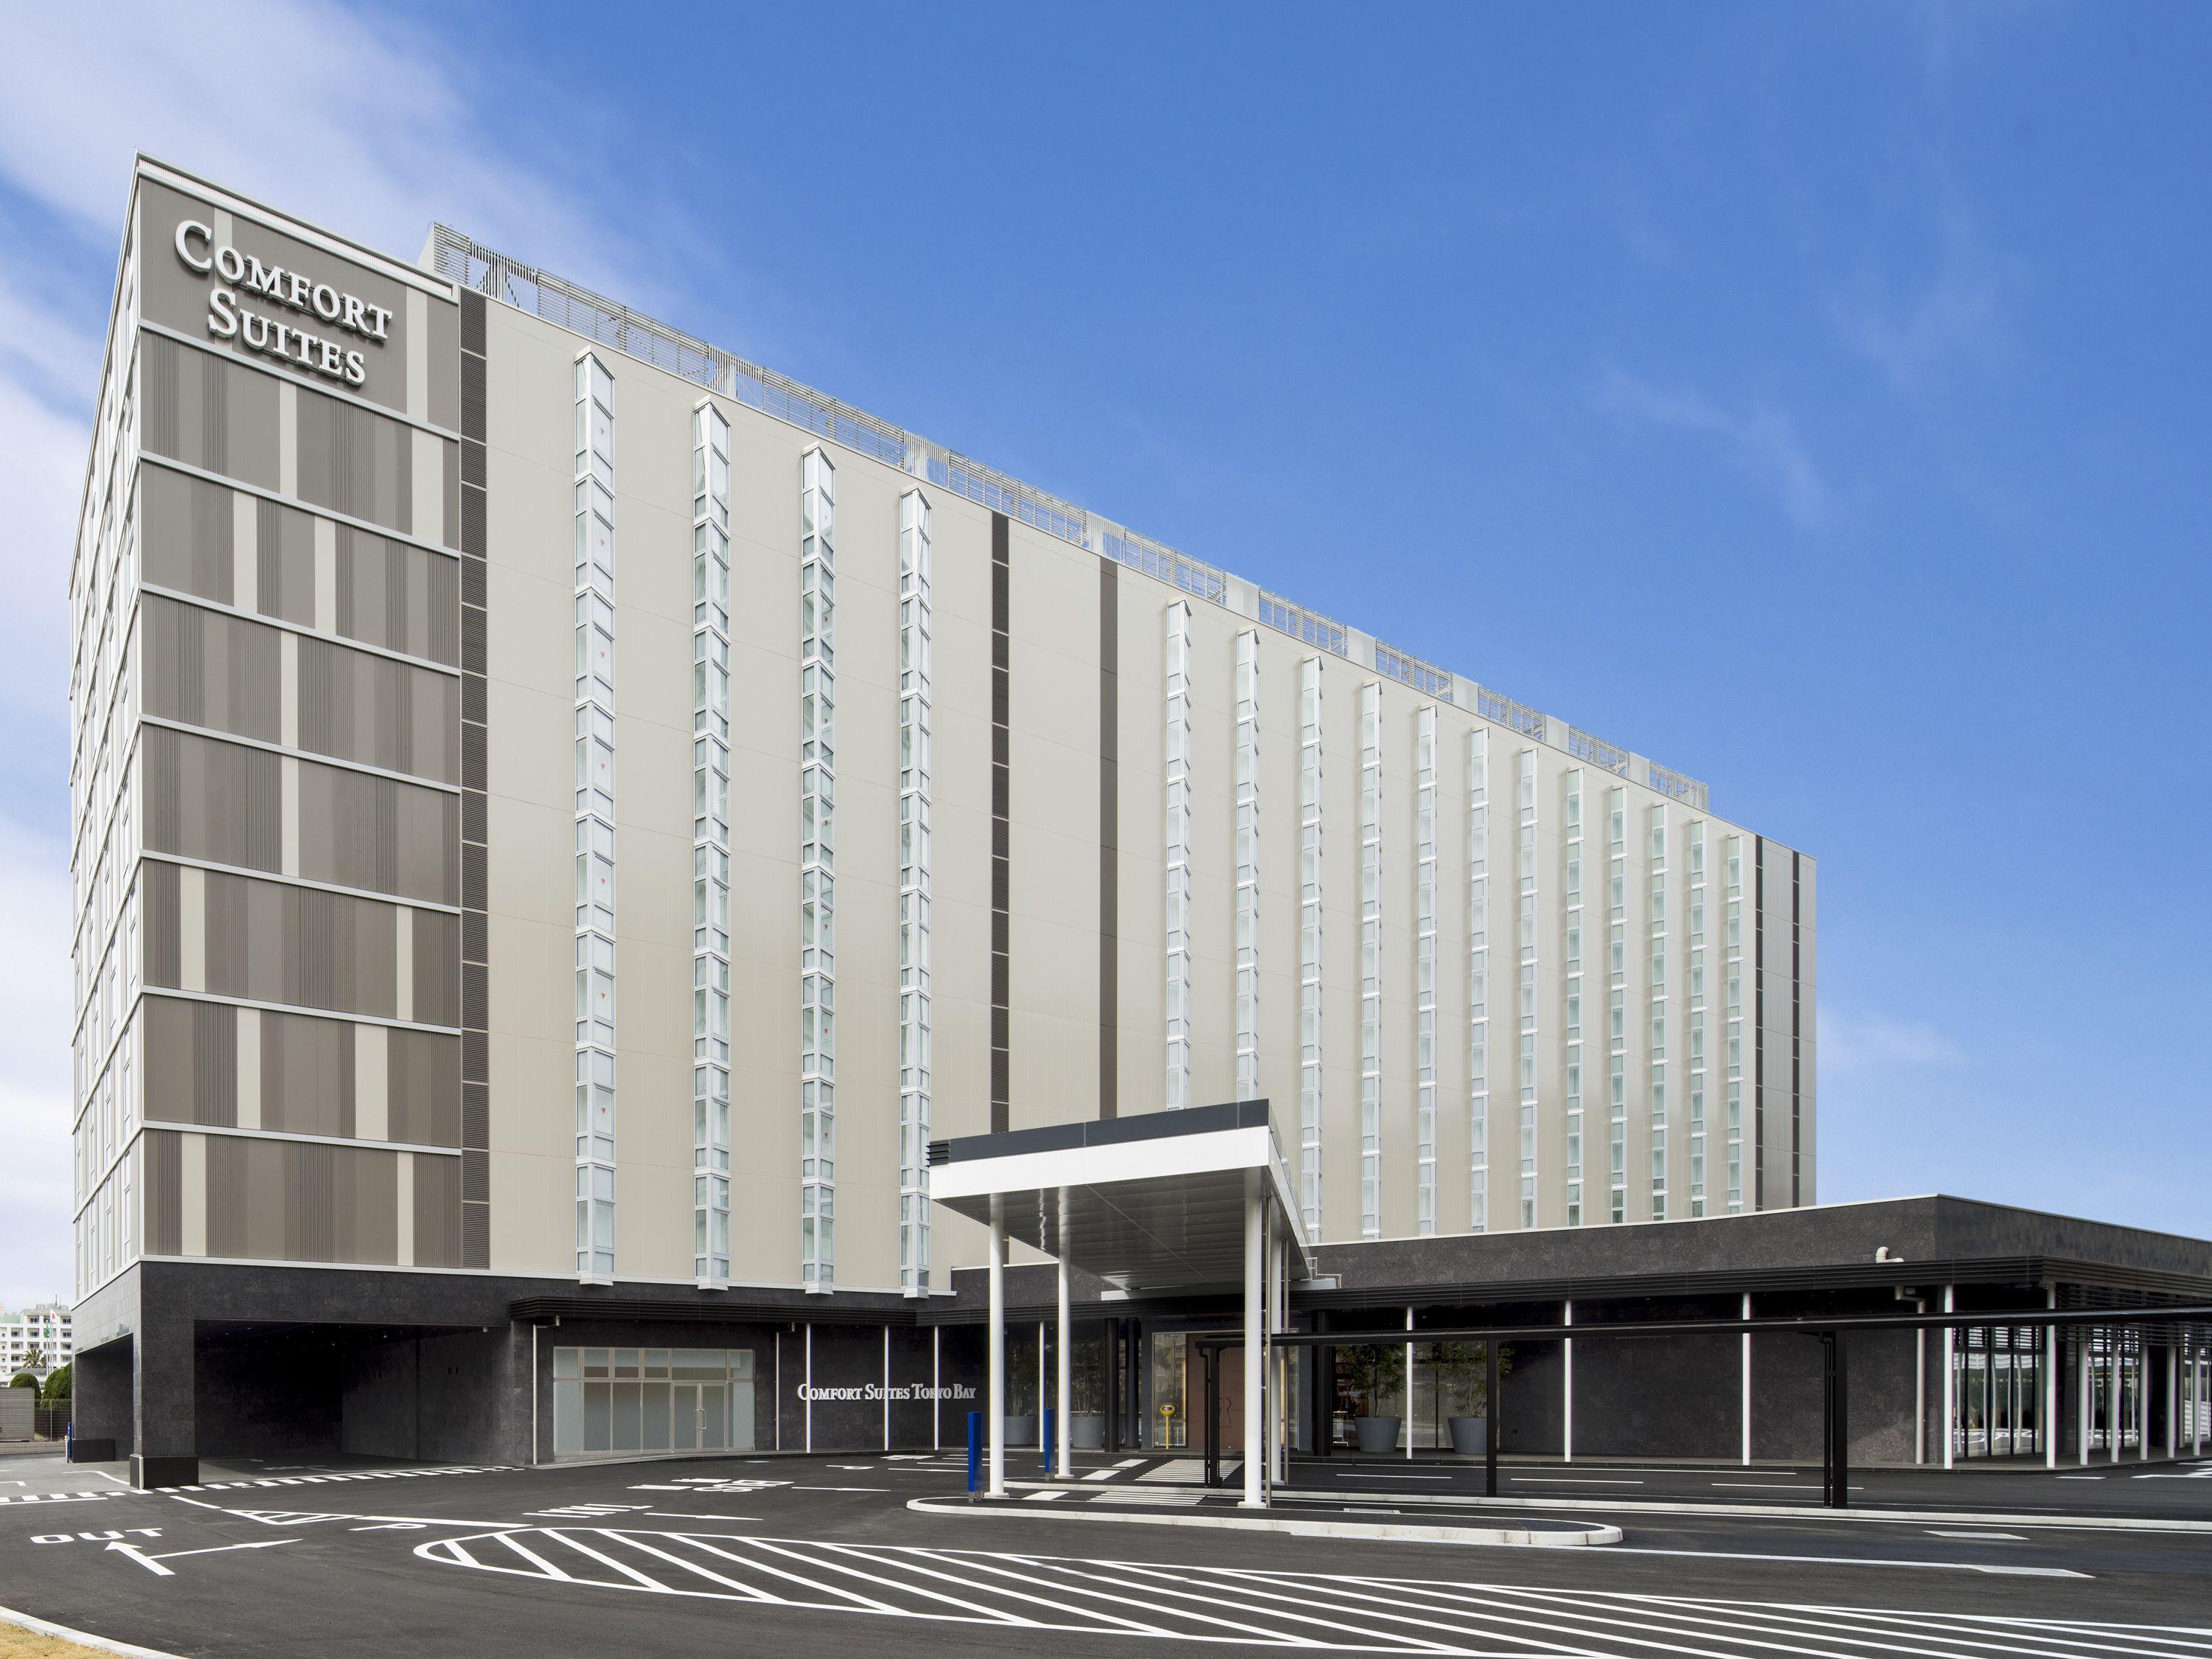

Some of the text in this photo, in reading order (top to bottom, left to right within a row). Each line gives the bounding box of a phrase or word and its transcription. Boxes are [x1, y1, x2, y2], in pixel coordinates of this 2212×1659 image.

[175, 220, 392, 342] COMFORT
[208, 288, 366, 386] SUITES
[797, 1383, 863, 1400] COMFORT
[953, 1383, 977, 1399] BAY
[30, 1528, 162, 1544] OUT
